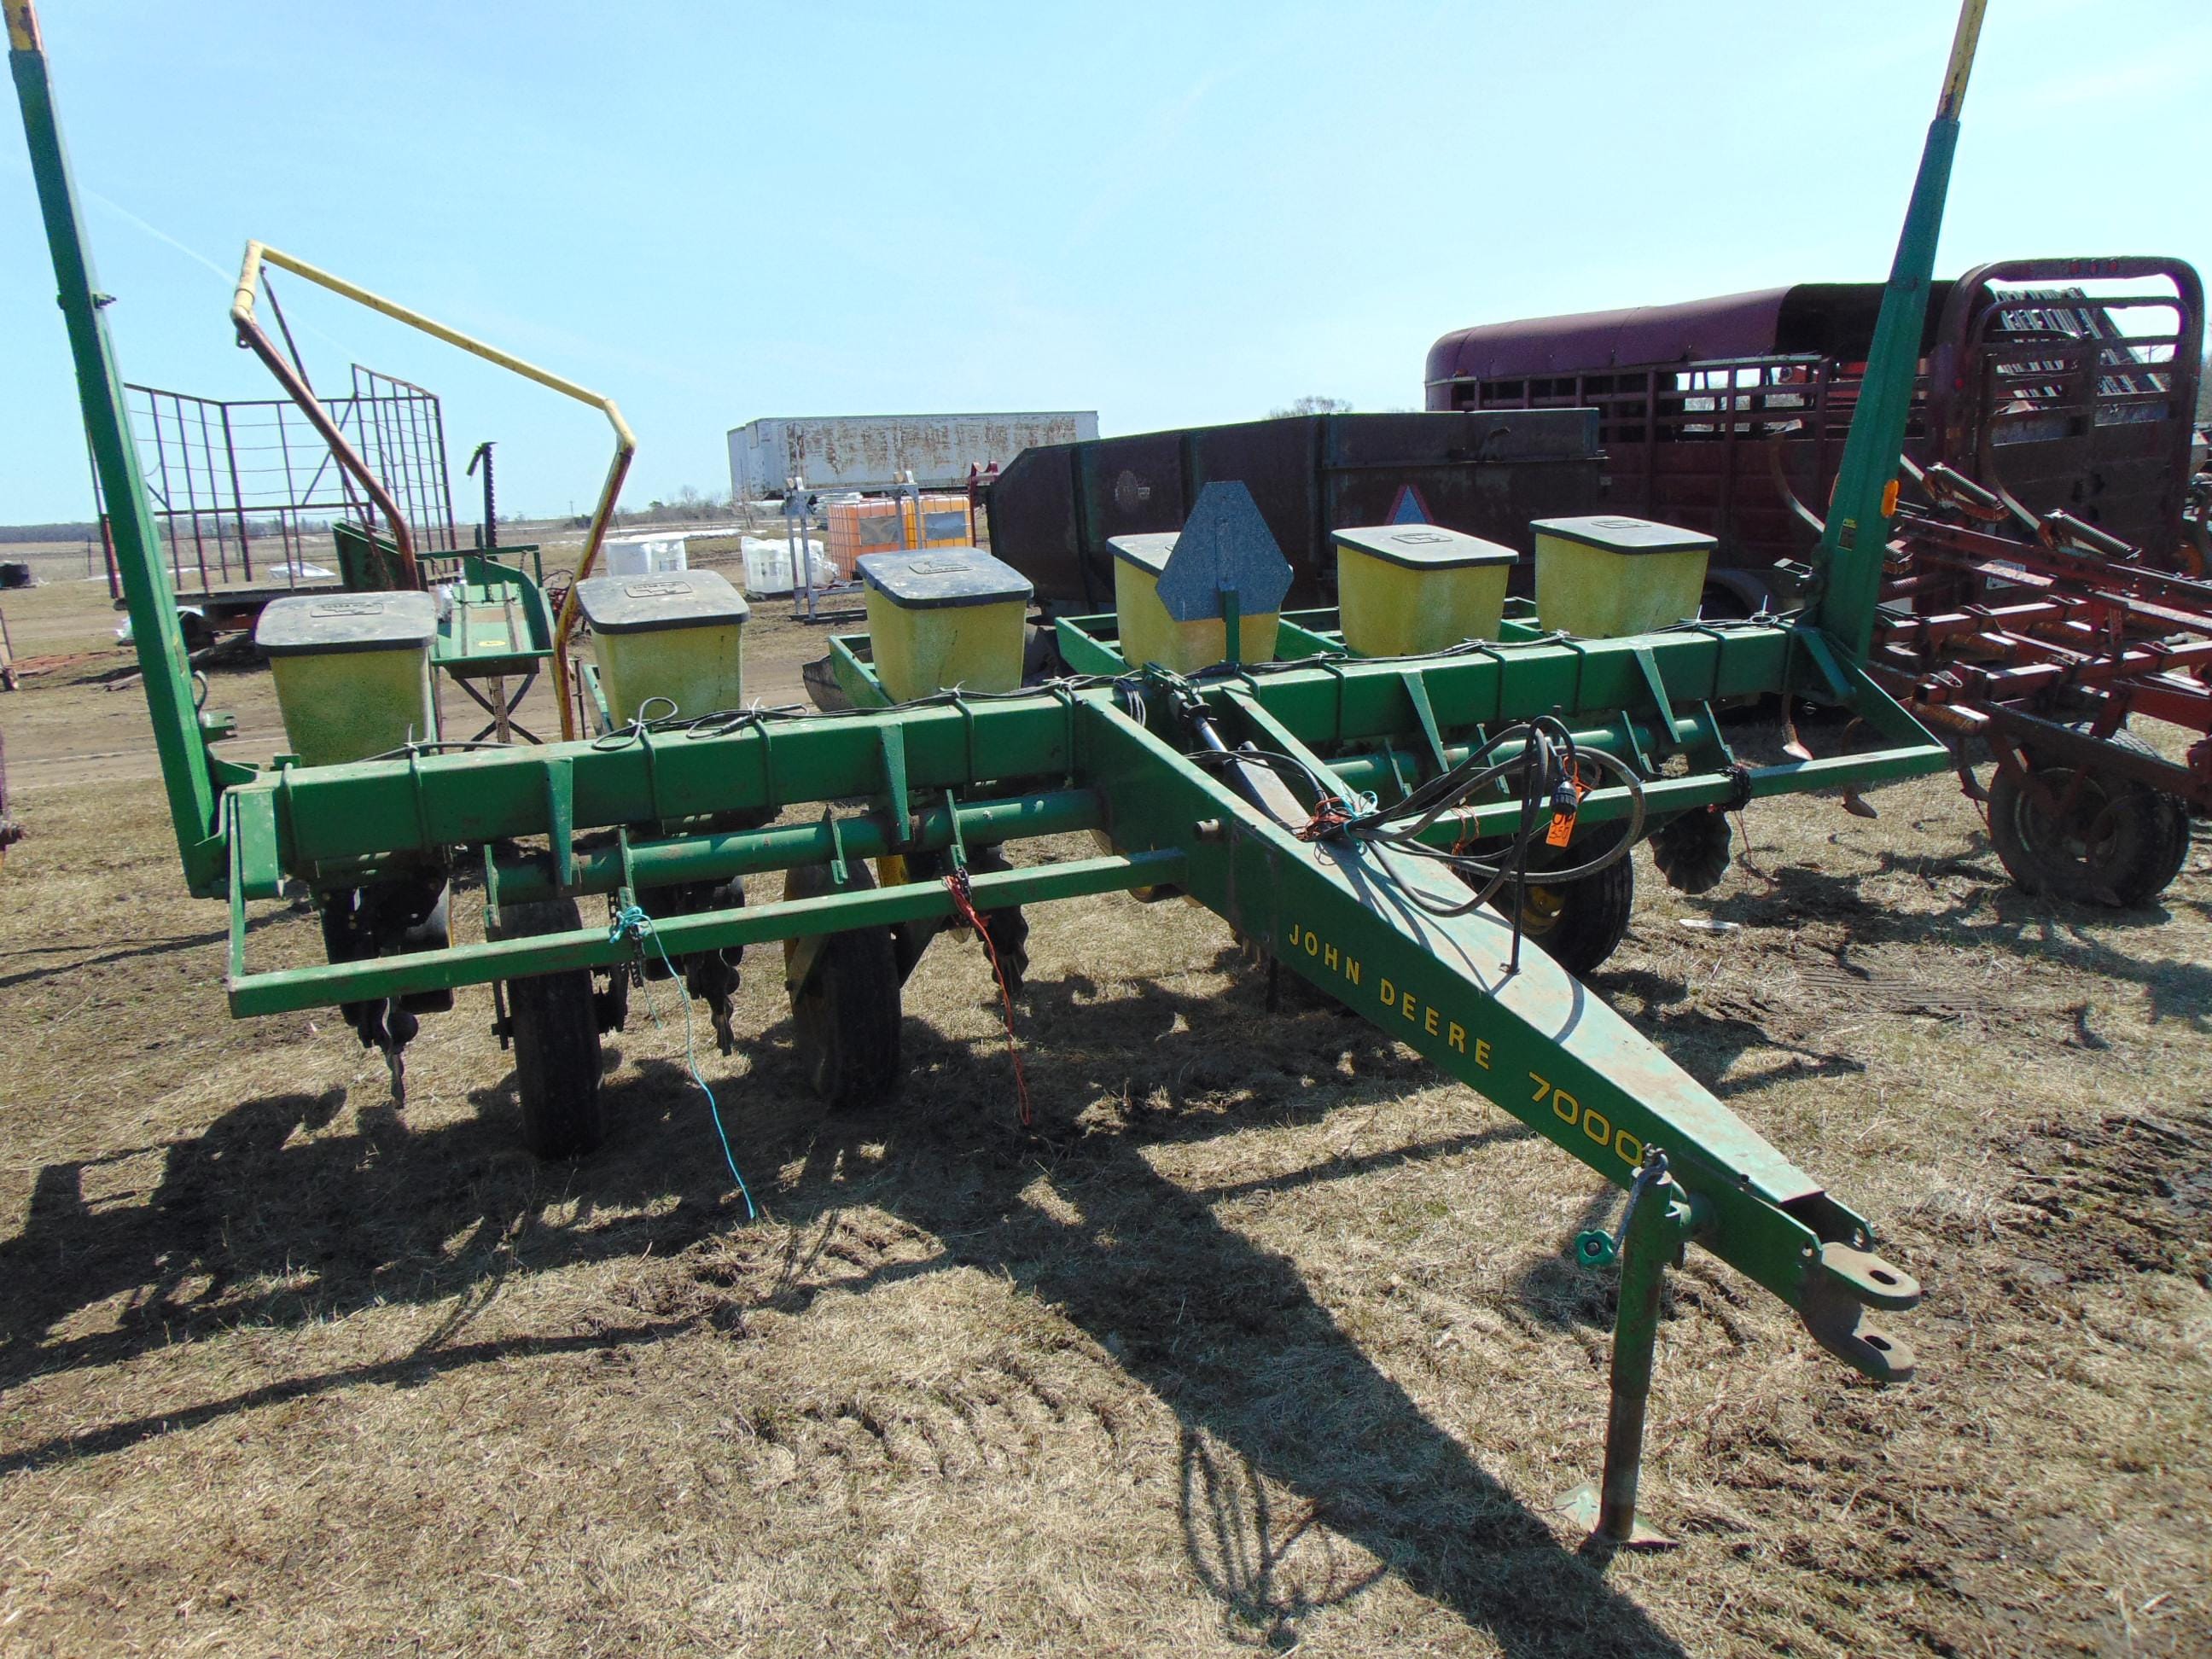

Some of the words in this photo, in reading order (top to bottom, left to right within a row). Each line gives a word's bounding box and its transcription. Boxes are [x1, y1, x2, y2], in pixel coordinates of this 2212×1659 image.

[1289, 923, 1359, 986] JOHN
[1379, 977, 1492, 1070] DEERE
[1528, 1071, 1645, 1168] 7000
